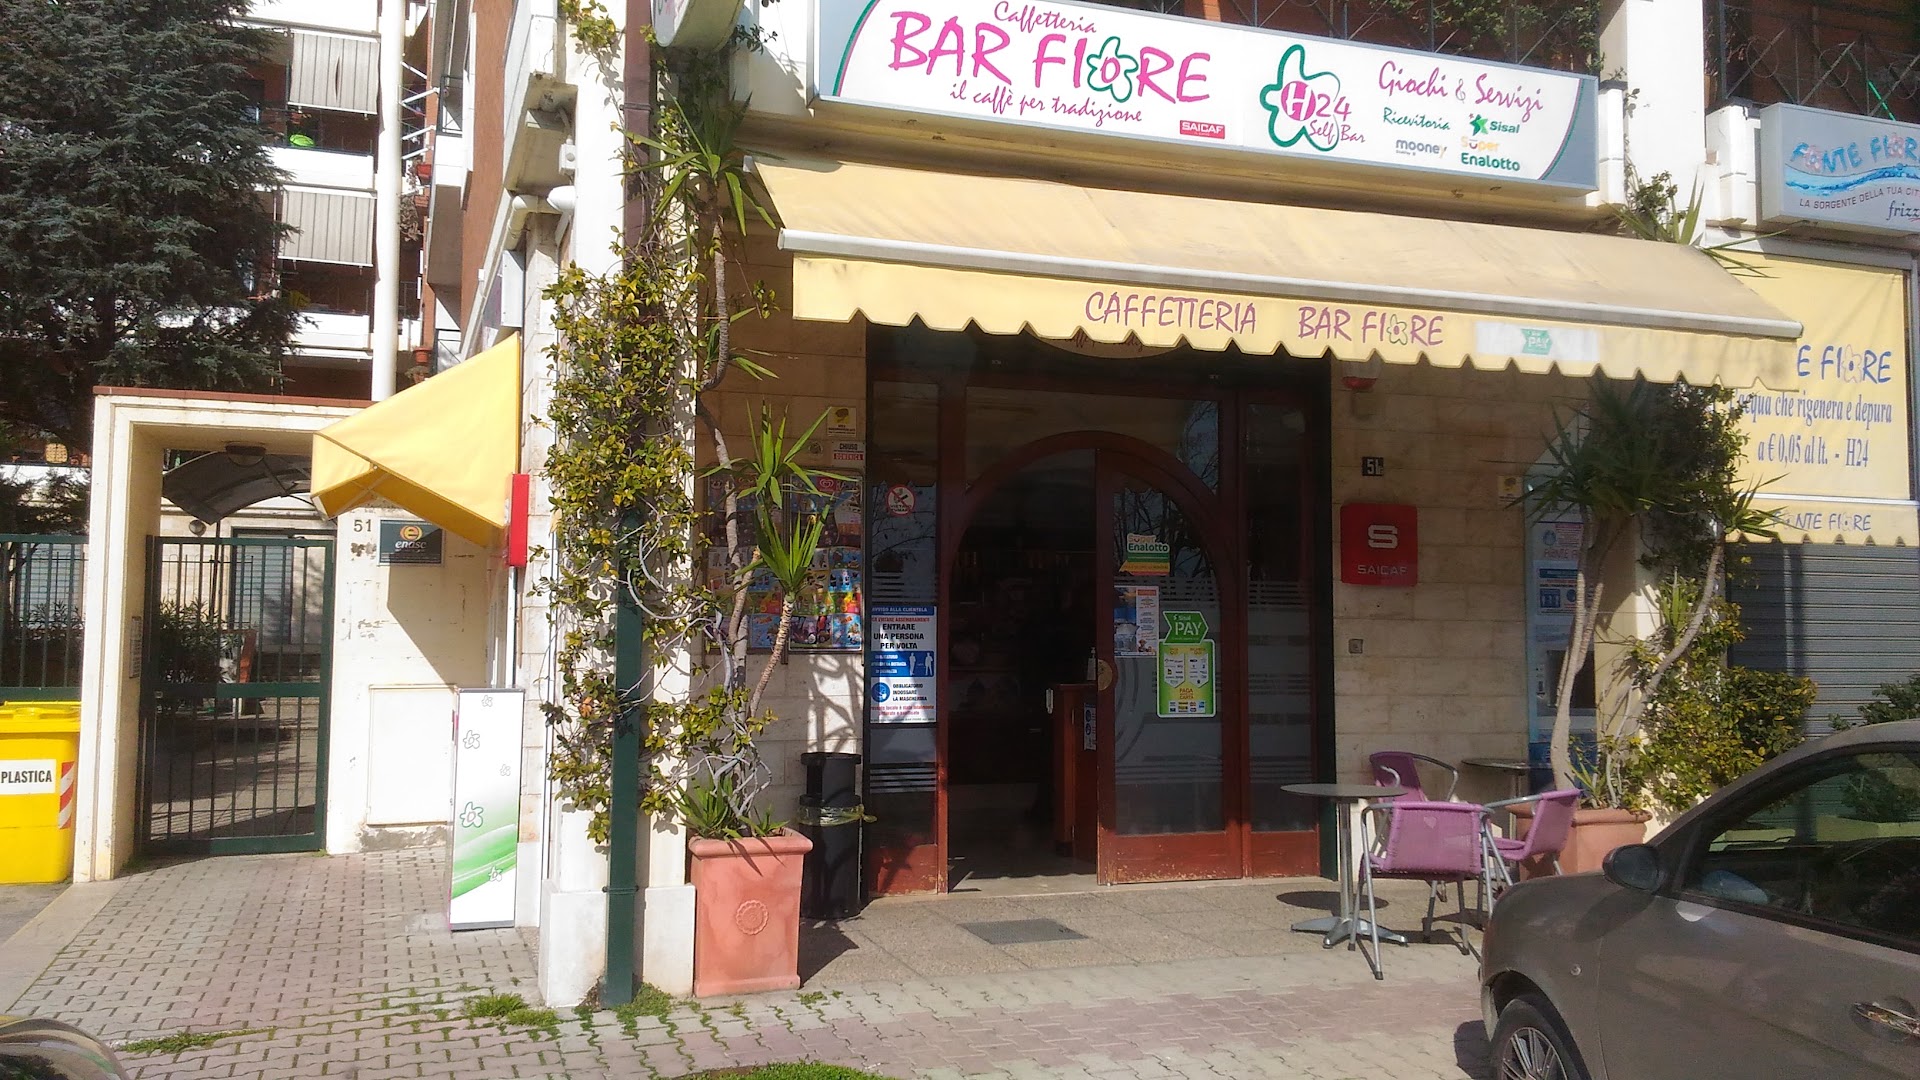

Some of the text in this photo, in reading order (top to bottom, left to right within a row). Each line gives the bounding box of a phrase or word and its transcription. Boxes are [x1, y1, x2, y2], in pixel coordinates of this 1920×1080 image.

[994, 0, 1097, 33] Caffetteria
[888, 11, 1211, 104] BAR FIORE
[1284, 81, 1352, 122] H24
[1378, 60, 1544, 122] Giochi & Servizi
[950, 79, 1142, 128] il caffè per tradizione
[1182, 121, 1224, 135] SAICAF
[1383, 106, 1451, 131] Ricevitoria
[1490, 120, 1520, 134] Sisal
[1308, 119, 1366, 145] Self Bar
[1396, 139, 1447, 159] mooney
[1790, 132, 1920, 174] FONTE FIOR
[1461, 152, 1520, 172] Enalotto
[1799, 198, 1810, 208] LA
[1813, 197, 1857, 210] SORGENTE
[1859, 187, 1884, 202] DELLA
[1886, 186, 1902, 196] TUA
[1085, 291, 1444, 347] CAFFETTERIA BAR FIORE
[1820, 344, 1892, 384] FIORE
[1775, 391, 1794, 417] che
[1797, 389, 1843, 427] rigenera
[1845, 400, 1852, 420] e
[1855, 393, 1893, 430] depura
[1757, 440, 1765, 461] a
[1767, 433, 1776, 462] €
[1778, 433, 1802, 468] 0,05
[1804, 435, 1815, 465] al
[1817, 436, 1828, 465] lt.
[1845, 437, 1869, 468] H24
[353, 519, 373, 533] 51
[1829, 511, 1872, 532] FIORE
[394, 540, 427, 549] enasc
[1128, 542, 1168, 552] Enalotto
[1367, 524, 1398, 549] S
[1357, 564, 1408, 575] SAICAF
[882, 623, 916, 631] ENTRARE
[1175, 621, 1203, 636] PAY
[1, 769, 53, 784] PLASTICA
